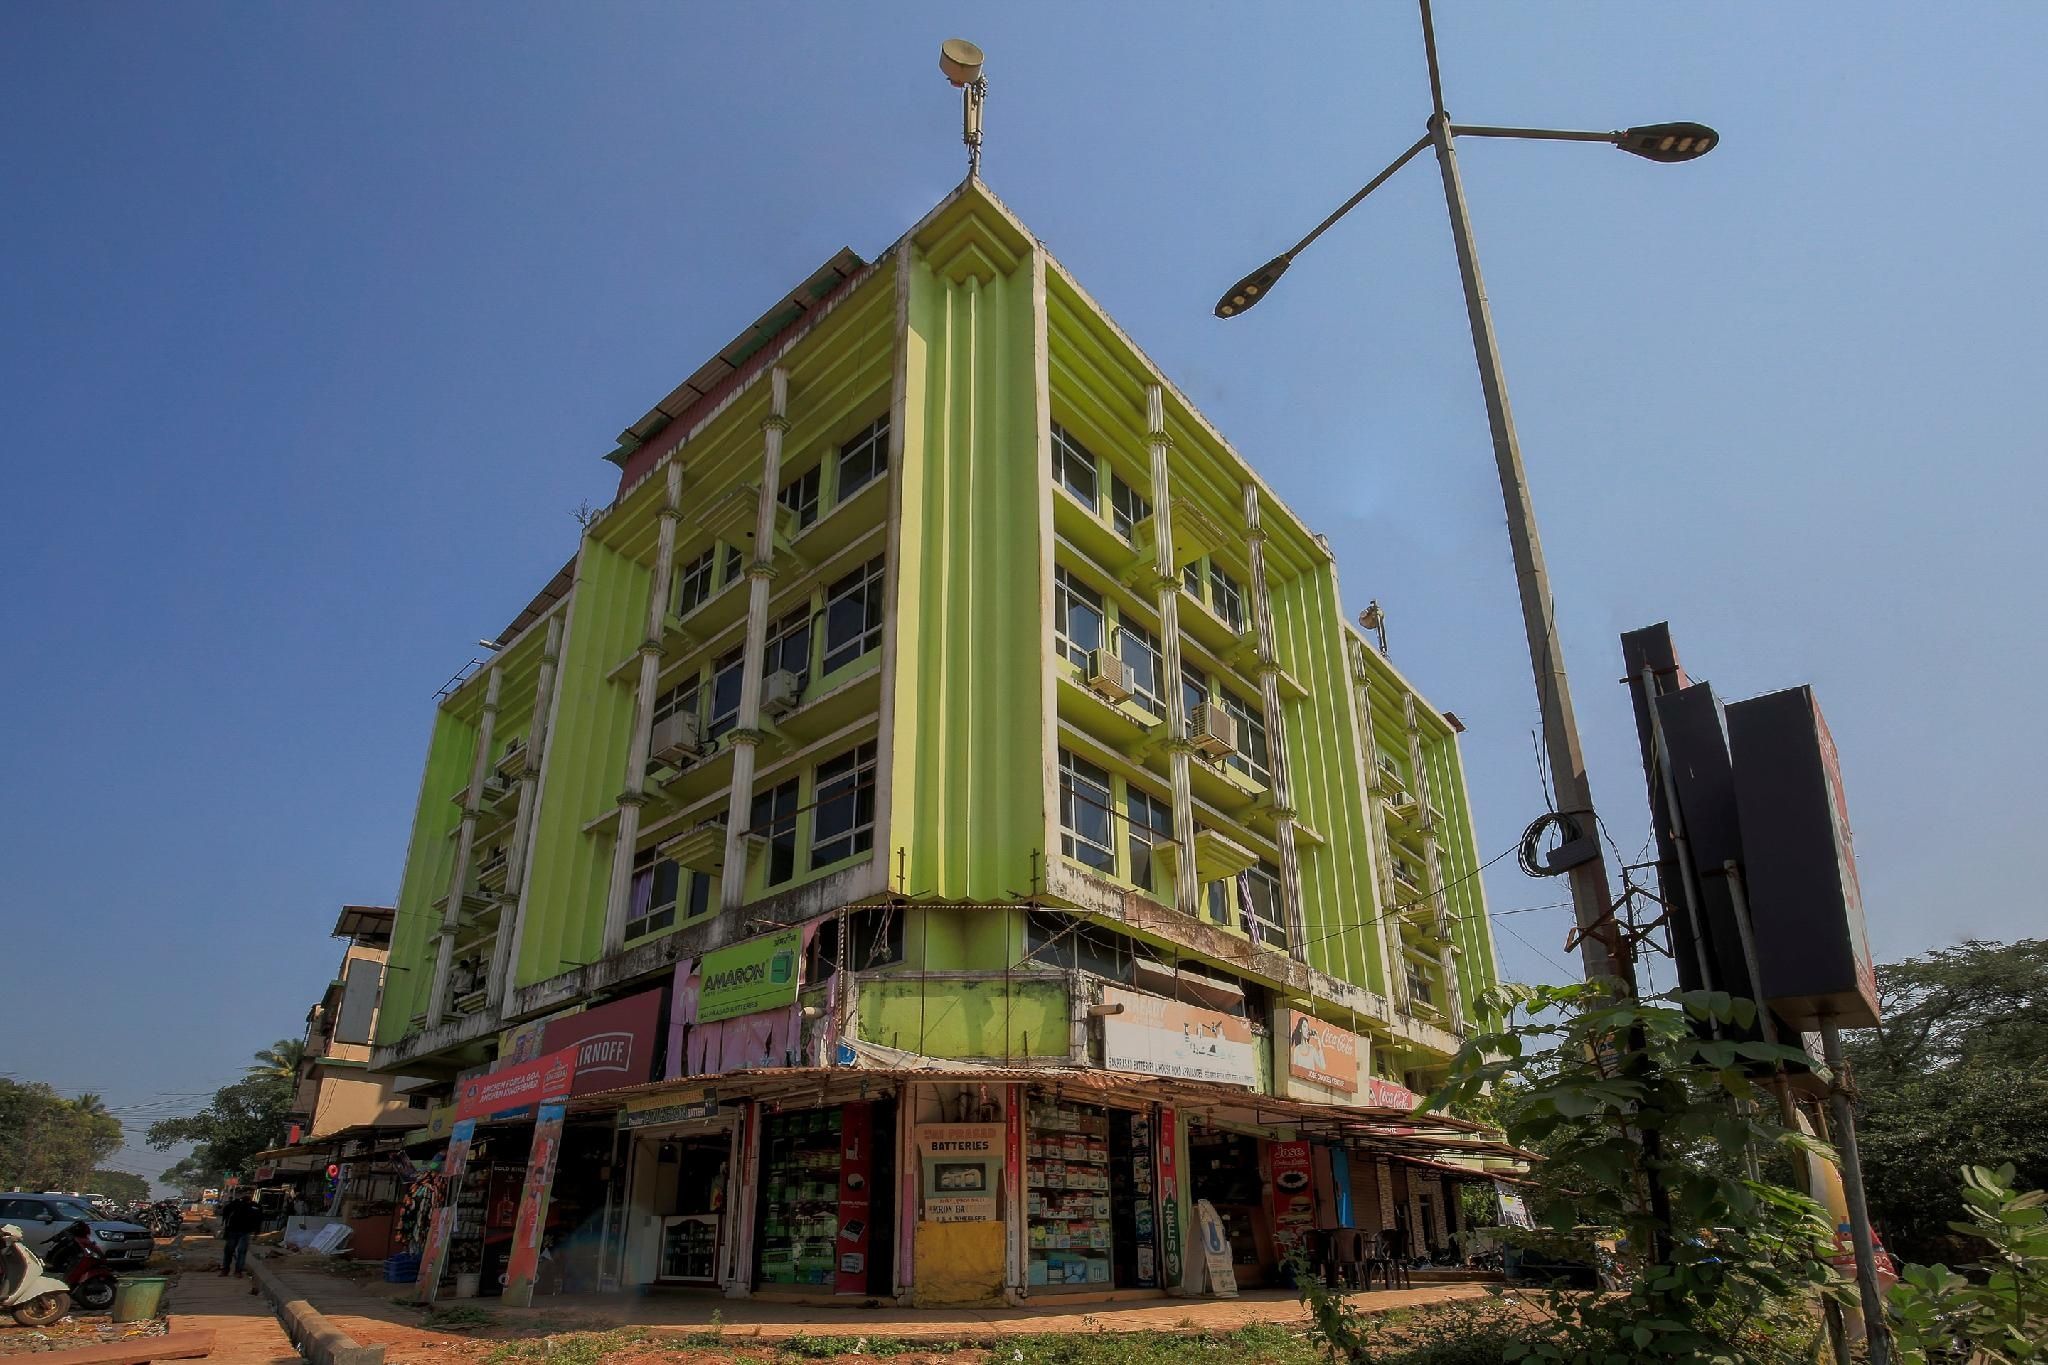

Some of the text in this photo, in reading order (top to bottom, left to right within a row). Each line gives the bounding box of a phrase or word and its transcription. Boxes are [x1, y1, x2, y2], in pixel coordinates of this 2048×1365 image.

[703, 962, 766, 992] AMARON
[931, 1141, 989, 1151] BATTERIES
[1274, 1143, 1305, 1159] Jose
